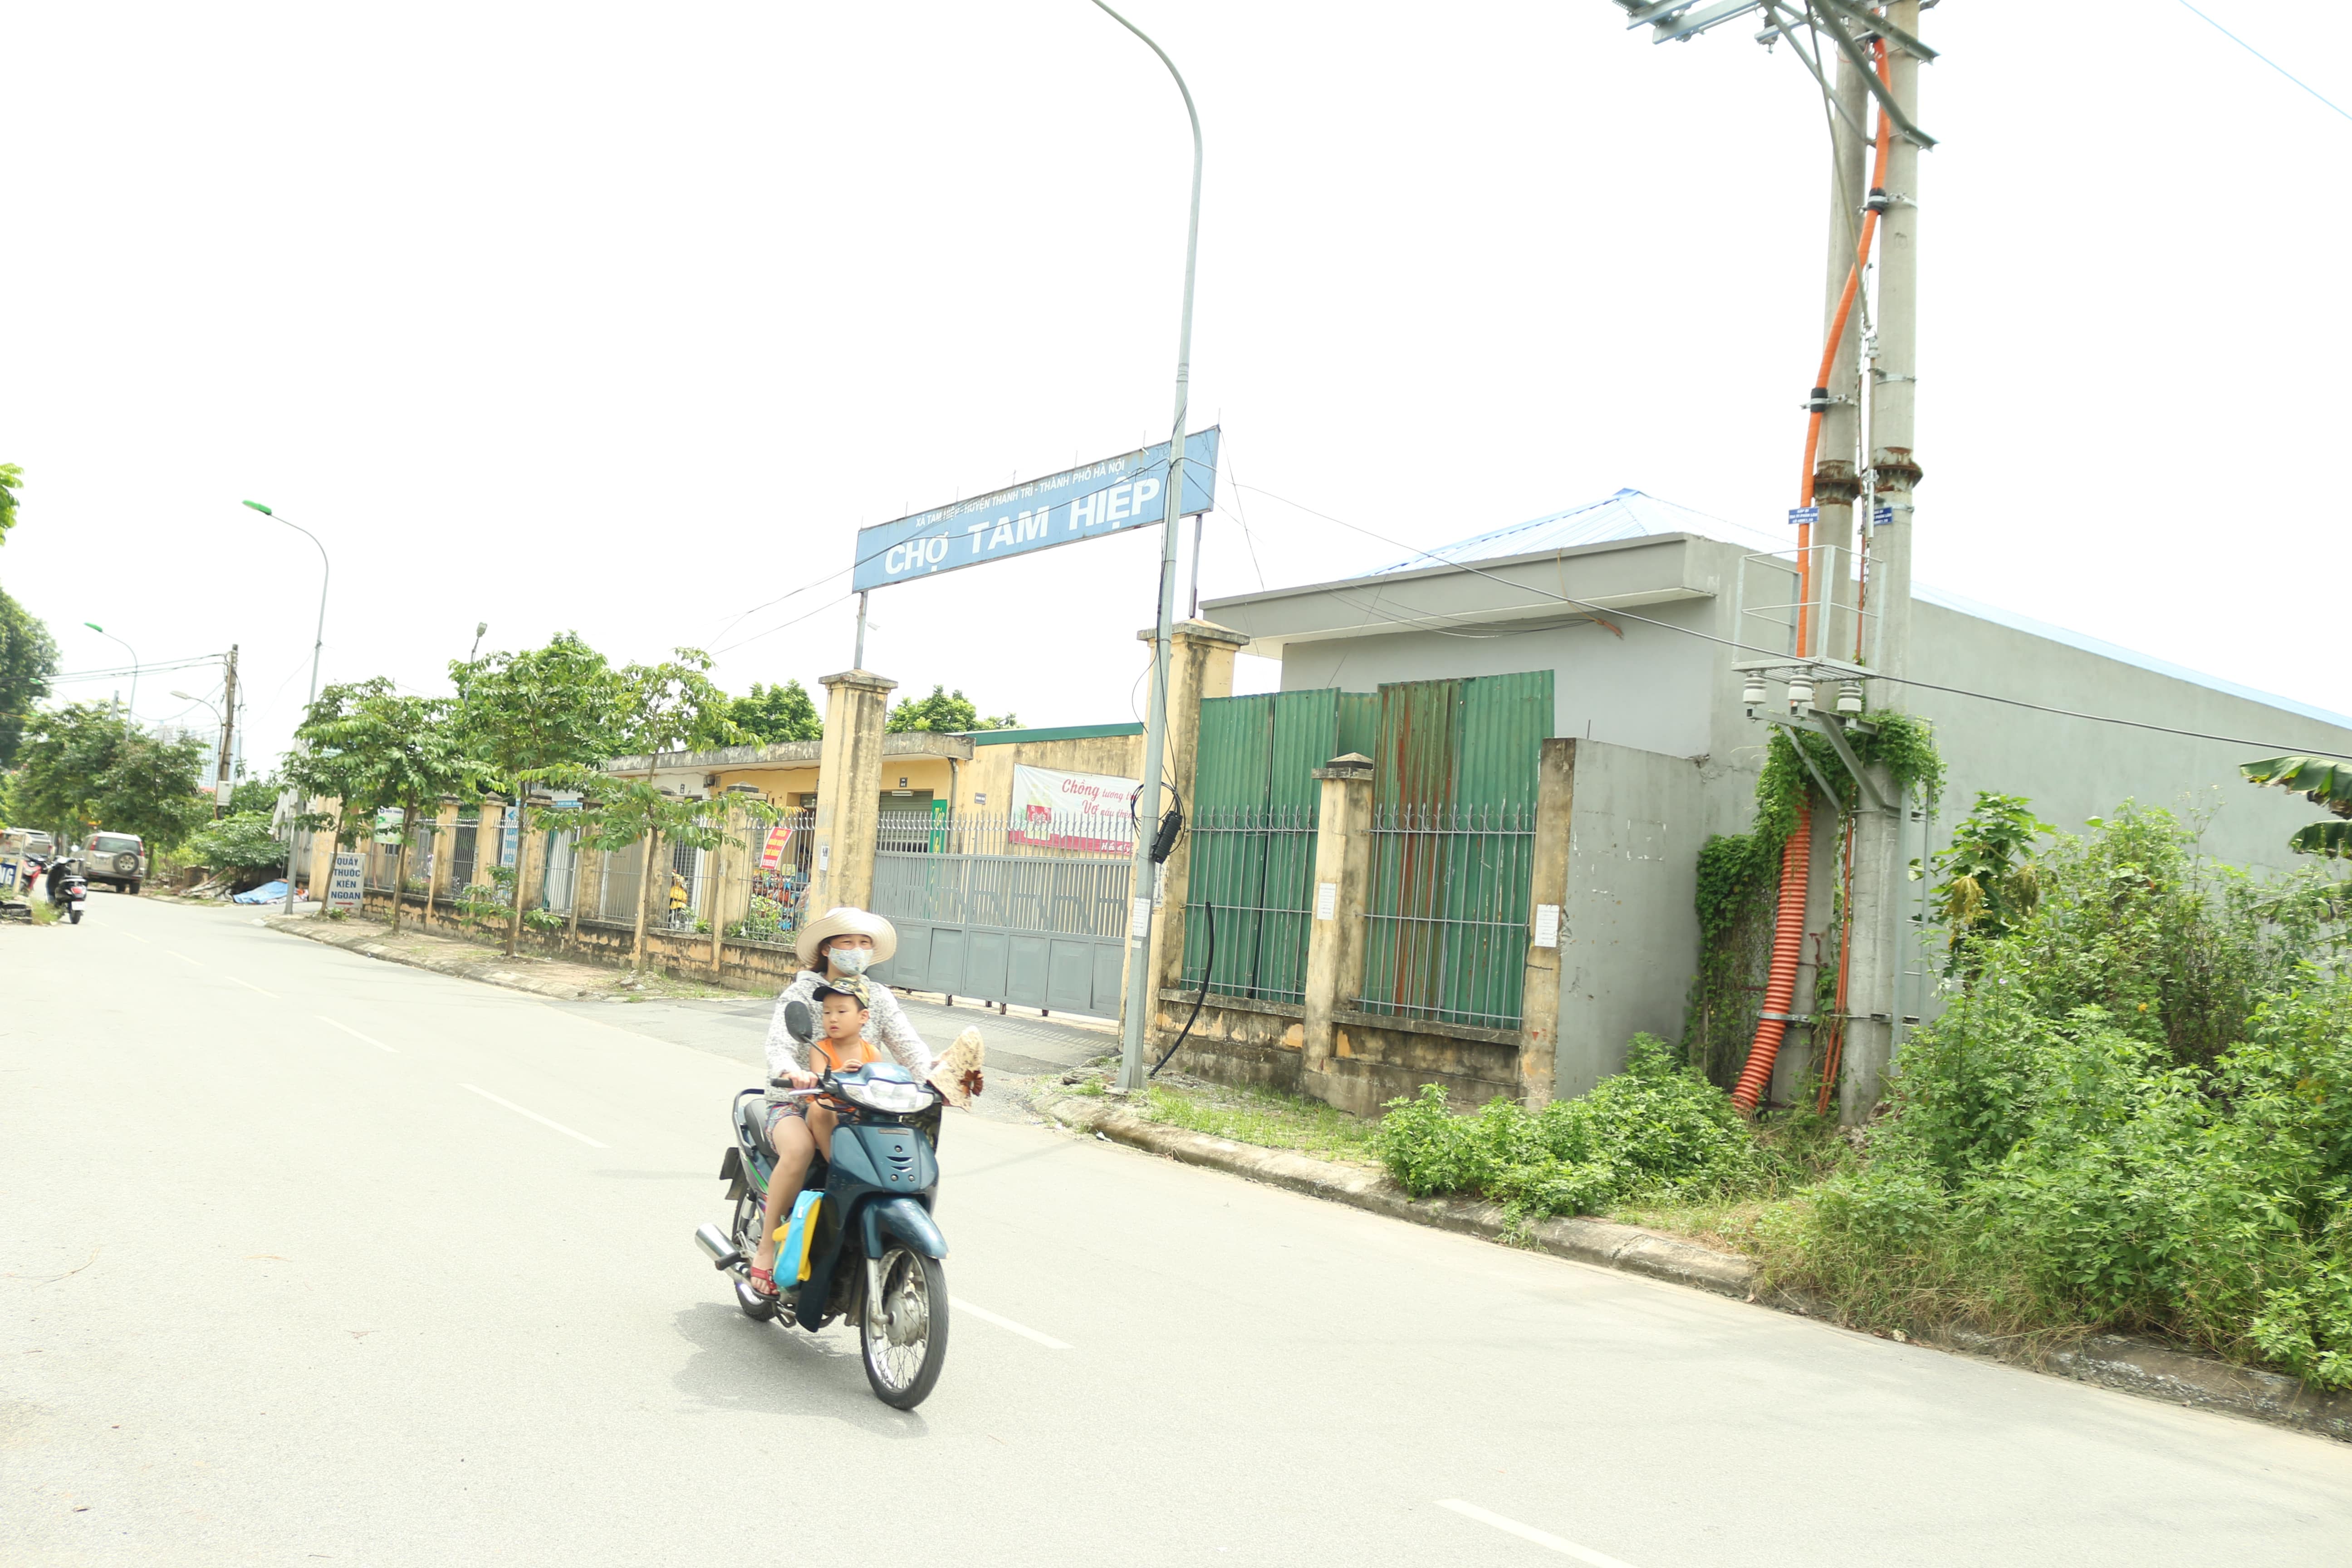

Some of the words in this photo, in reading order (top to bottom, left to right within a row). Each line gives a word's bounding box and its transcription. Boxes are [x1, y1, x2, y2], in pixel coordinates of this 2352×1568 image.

[916, 514, 926, 528] XÃ
[926, 512, 942, 524] TAM
[943, 505, 960, 521] HIỆP
[964, 497, 990, 514] HUYỆN
[992, 490, 1018, 506] THANH
[1020, 483, 1034, 499] TRÌ
[1039, 475, 1069, 493] THÀNH
[1072, 464, 1092, 484] PHỐ
[1093, 462, 1106, 479] HÀ
[1108, 458, 1125, 475] NỘI
[885, 531, 950, 575] CHỢ
[967, 505, 1050, 554] TAM
[1069, 476, 1160, 530] HIỆP
[1062, 779, 1100, 802] Chồng
[1102, 789, 1124, 803] tương
[1082, 799, 1100, 818] Vợ
[1100, 806, 1115, 817] nấu
[334, 867, 361, 877] THUỐC
[336, 879, 356, 888] KIÊN
[331, 891, 361, 899] NGOAN
